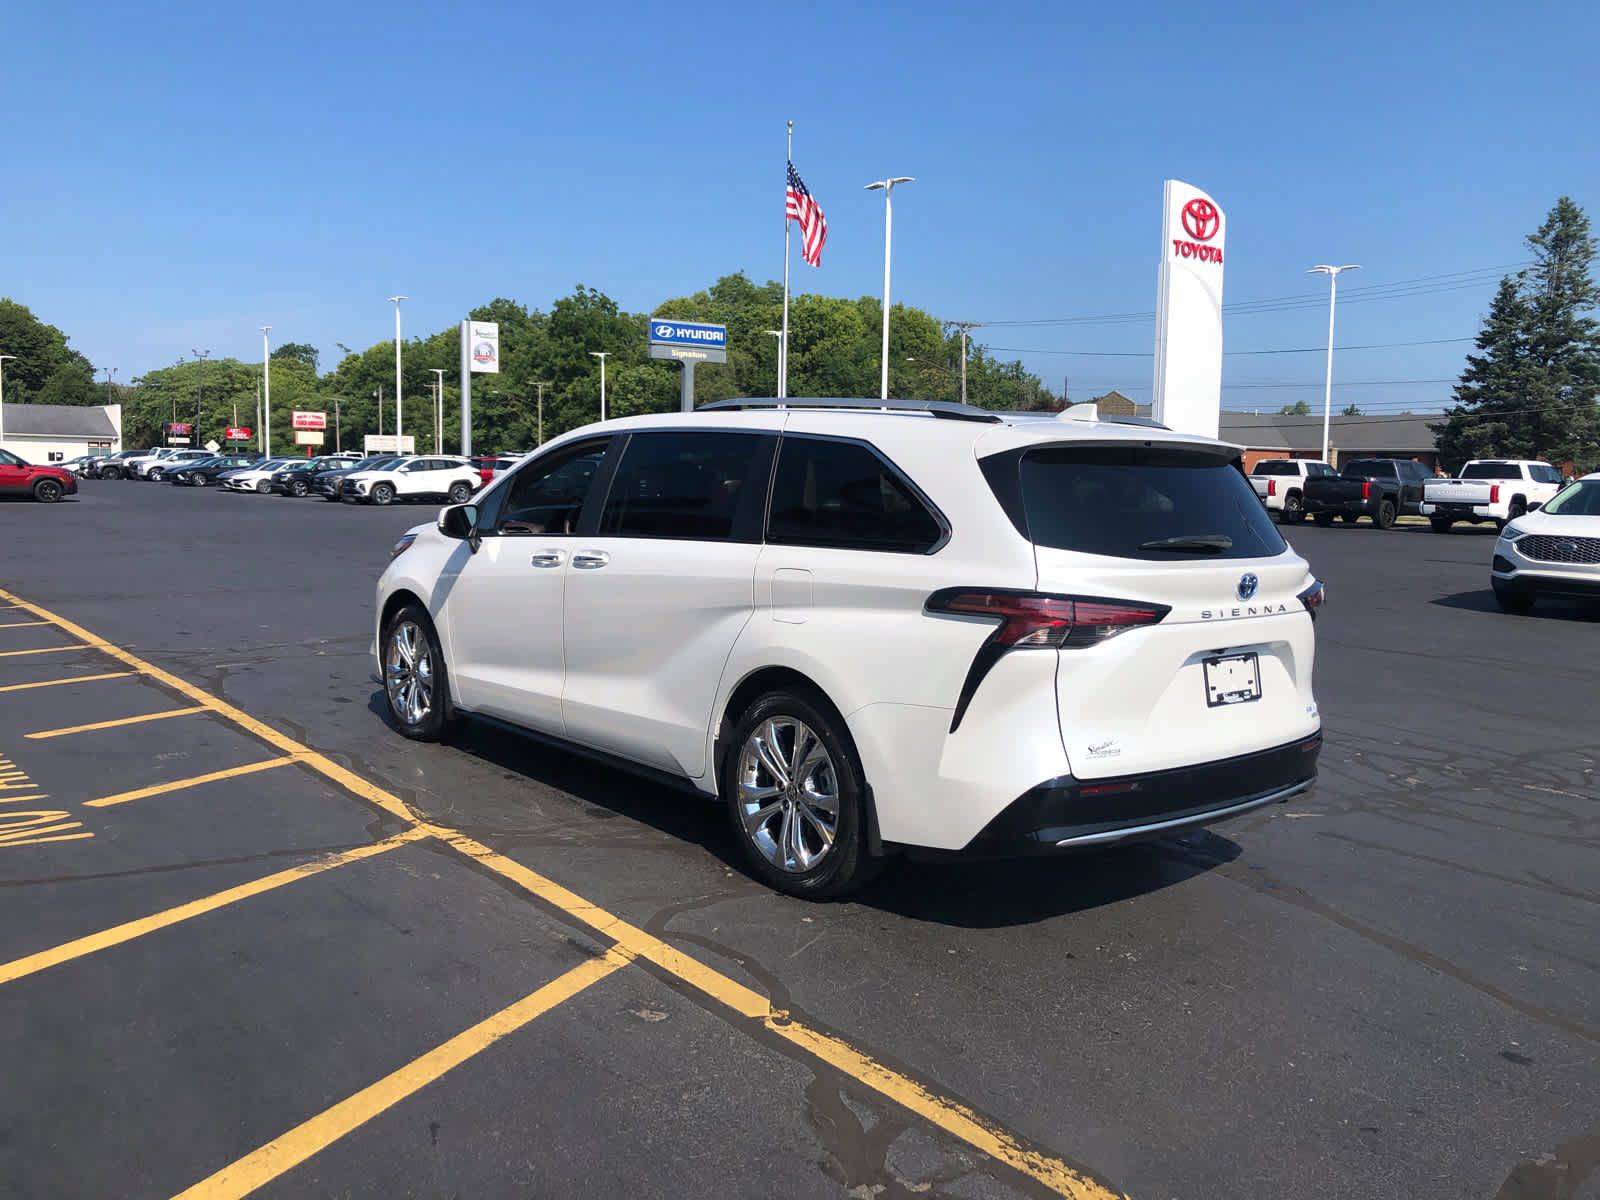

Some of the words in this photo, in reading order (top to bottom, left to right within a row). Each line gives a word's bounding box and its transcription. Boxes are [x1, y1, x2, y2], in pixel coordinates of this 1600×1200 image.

[1173, 240, 1223, 265] TOYOTA
[676, 327, 724, 341] HYUNDAI
[671, 349, 707, 359] Signature
[1201, 604, 1287, 619] SIENNA
